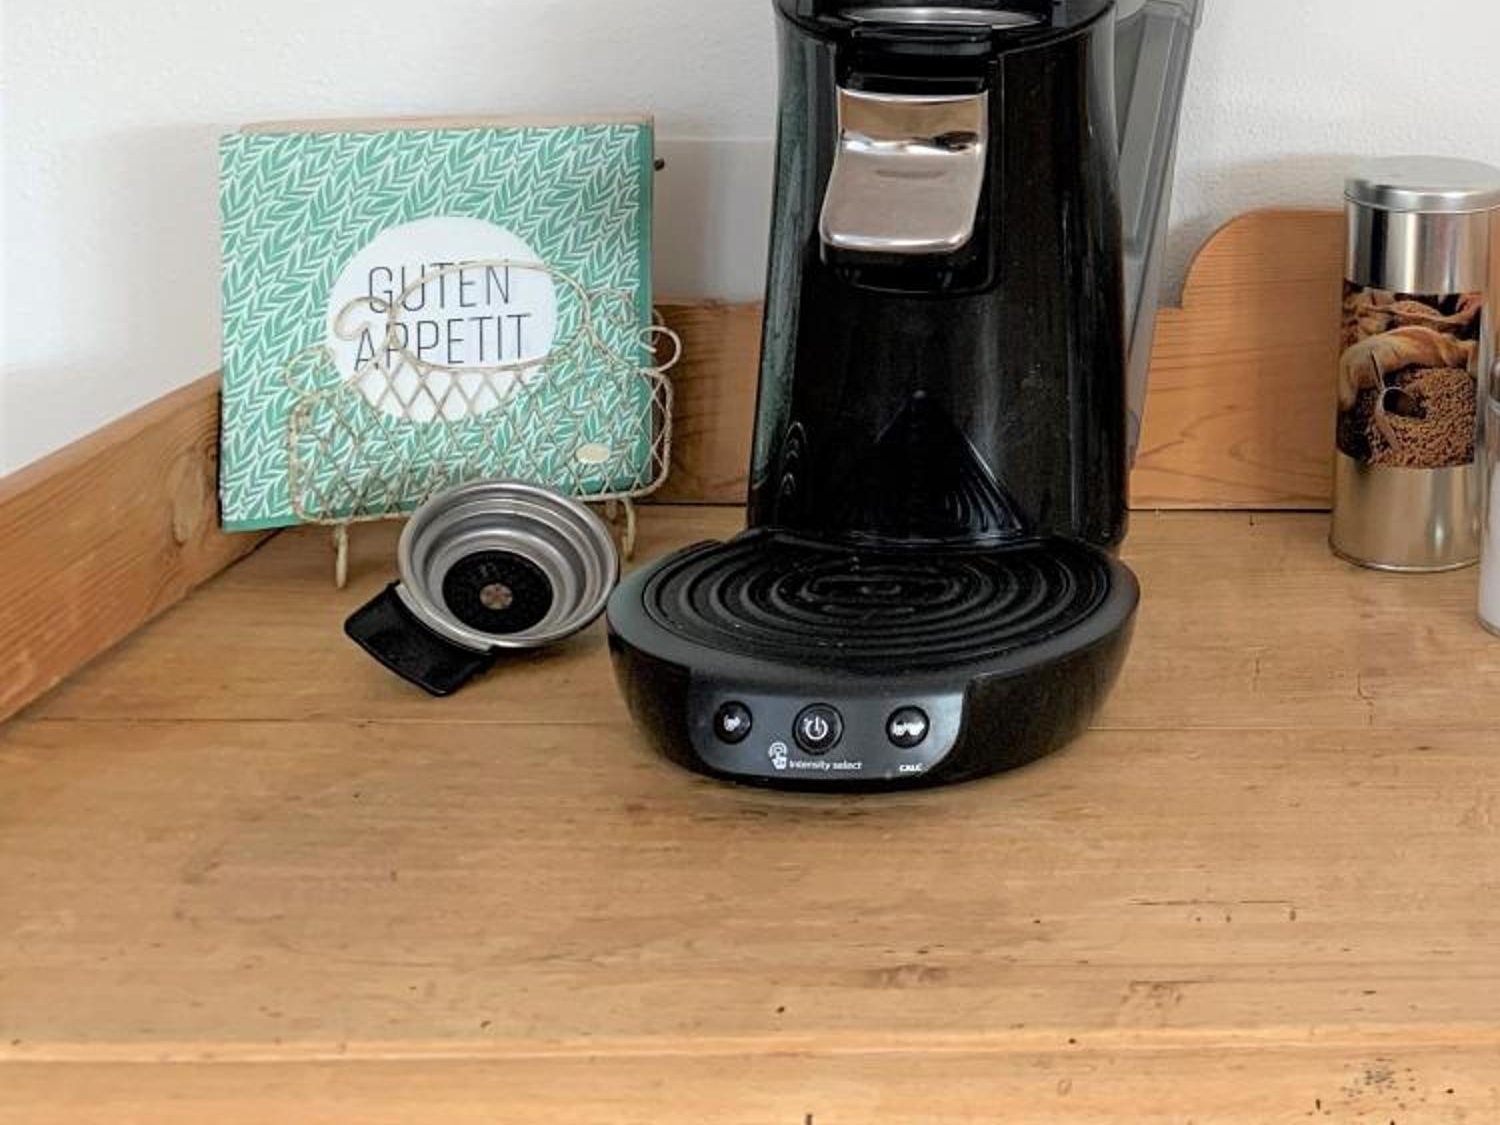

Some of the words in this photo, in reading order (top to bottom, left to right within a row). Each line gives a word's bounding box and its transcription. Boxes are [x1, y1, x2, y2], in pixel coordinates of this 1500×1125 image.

[369, 260, 509, 313] GUTEN
[354, 313, 531, 371] APPETIT
[832, 759, 862, 770] select
[899, 763, 924, 772] CALC
